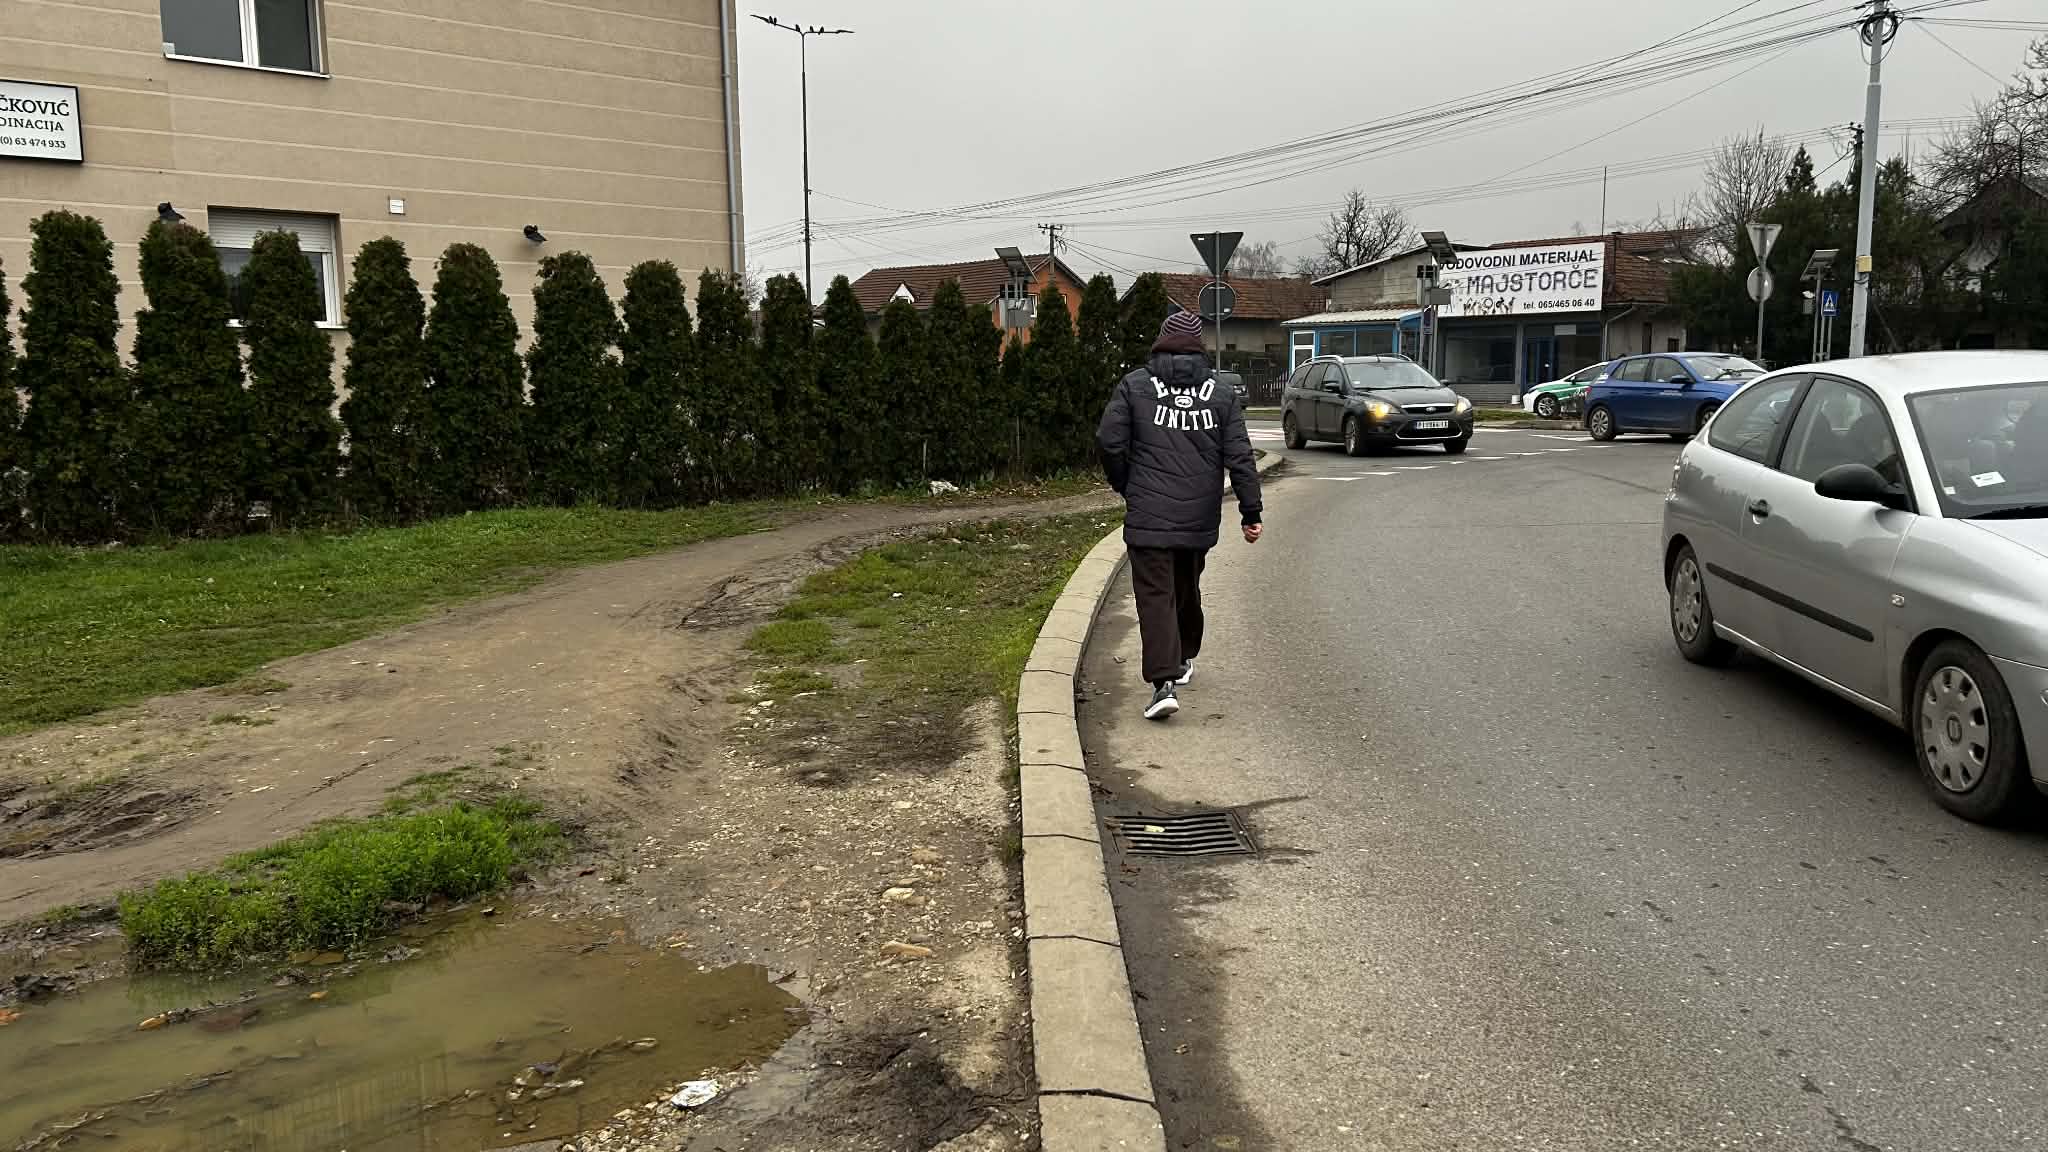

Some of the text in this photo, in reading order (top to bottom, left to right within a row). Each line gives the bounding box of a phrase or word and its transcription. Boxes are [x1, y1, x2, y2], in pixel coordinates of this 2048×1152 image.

[0, 136, 66, 149] (0) 63 474 933
[1519, 249, 1599, 266] MATERIJAL
[1467, 264, 1599, 295] MAJSTORČE
[1523, 301, 1536, 309] tel.
[1538, 299, 1570, 309] 065/465
[1584, 298, 1595, 306] 40
[1153, 404, 1218, 431] UNLTD.
